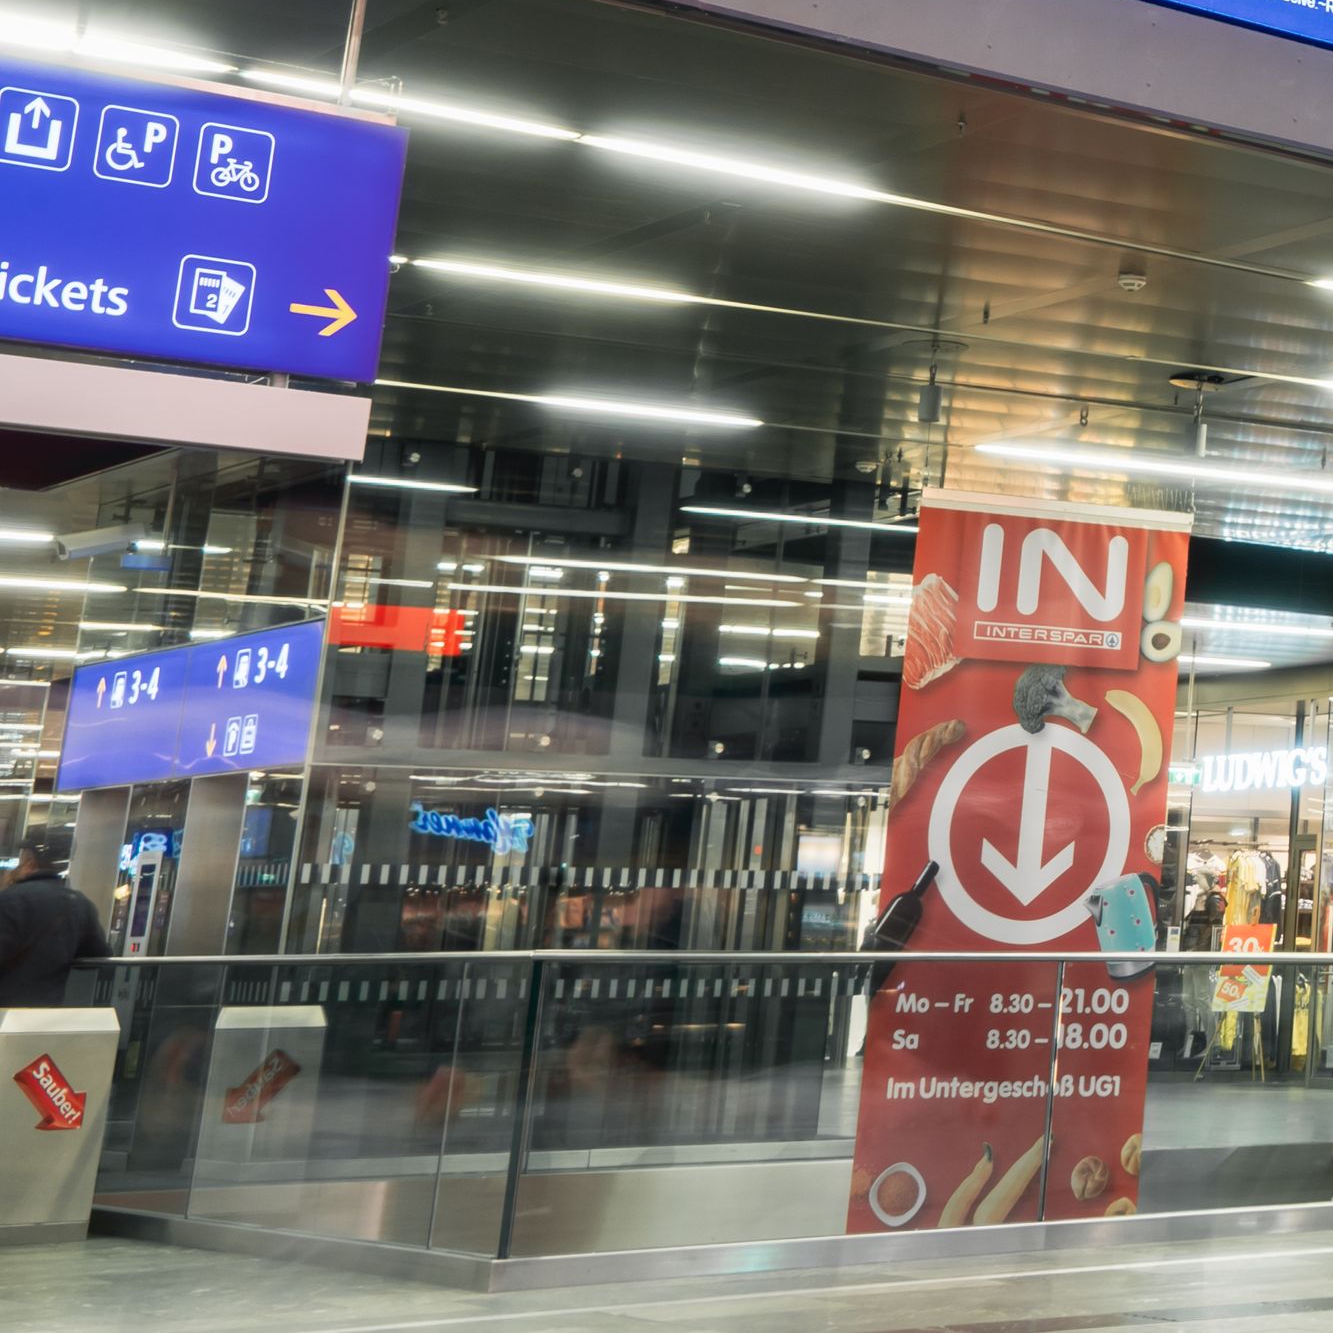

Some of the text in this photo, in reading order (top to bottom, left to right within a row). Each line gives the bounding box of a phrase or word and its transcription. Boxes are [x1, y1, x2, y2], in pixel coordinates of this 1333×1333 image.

[977, 523, 1129, 623] IN
[985, 625, 1103, 646] INTERSPAR
[254, 643, 289, 683] 3-4
[128, 667, 160, 704] 3-4
[895, 993, 930, 1013] Mo
[953, 993, 974, 1013] Fr
[989, 993, 1034, 1014] 8.30
[1062, 988, 1129, 1014] 21.00
[891, 1029, 919, 1050] Sa
[985, 1029, 1031, 1050] 8.30
[32, 1062, 82, 1124] Sauber!
[886, 1077, 915, 1099] Im
[1078, 1075, 1121, 1097] UG1
